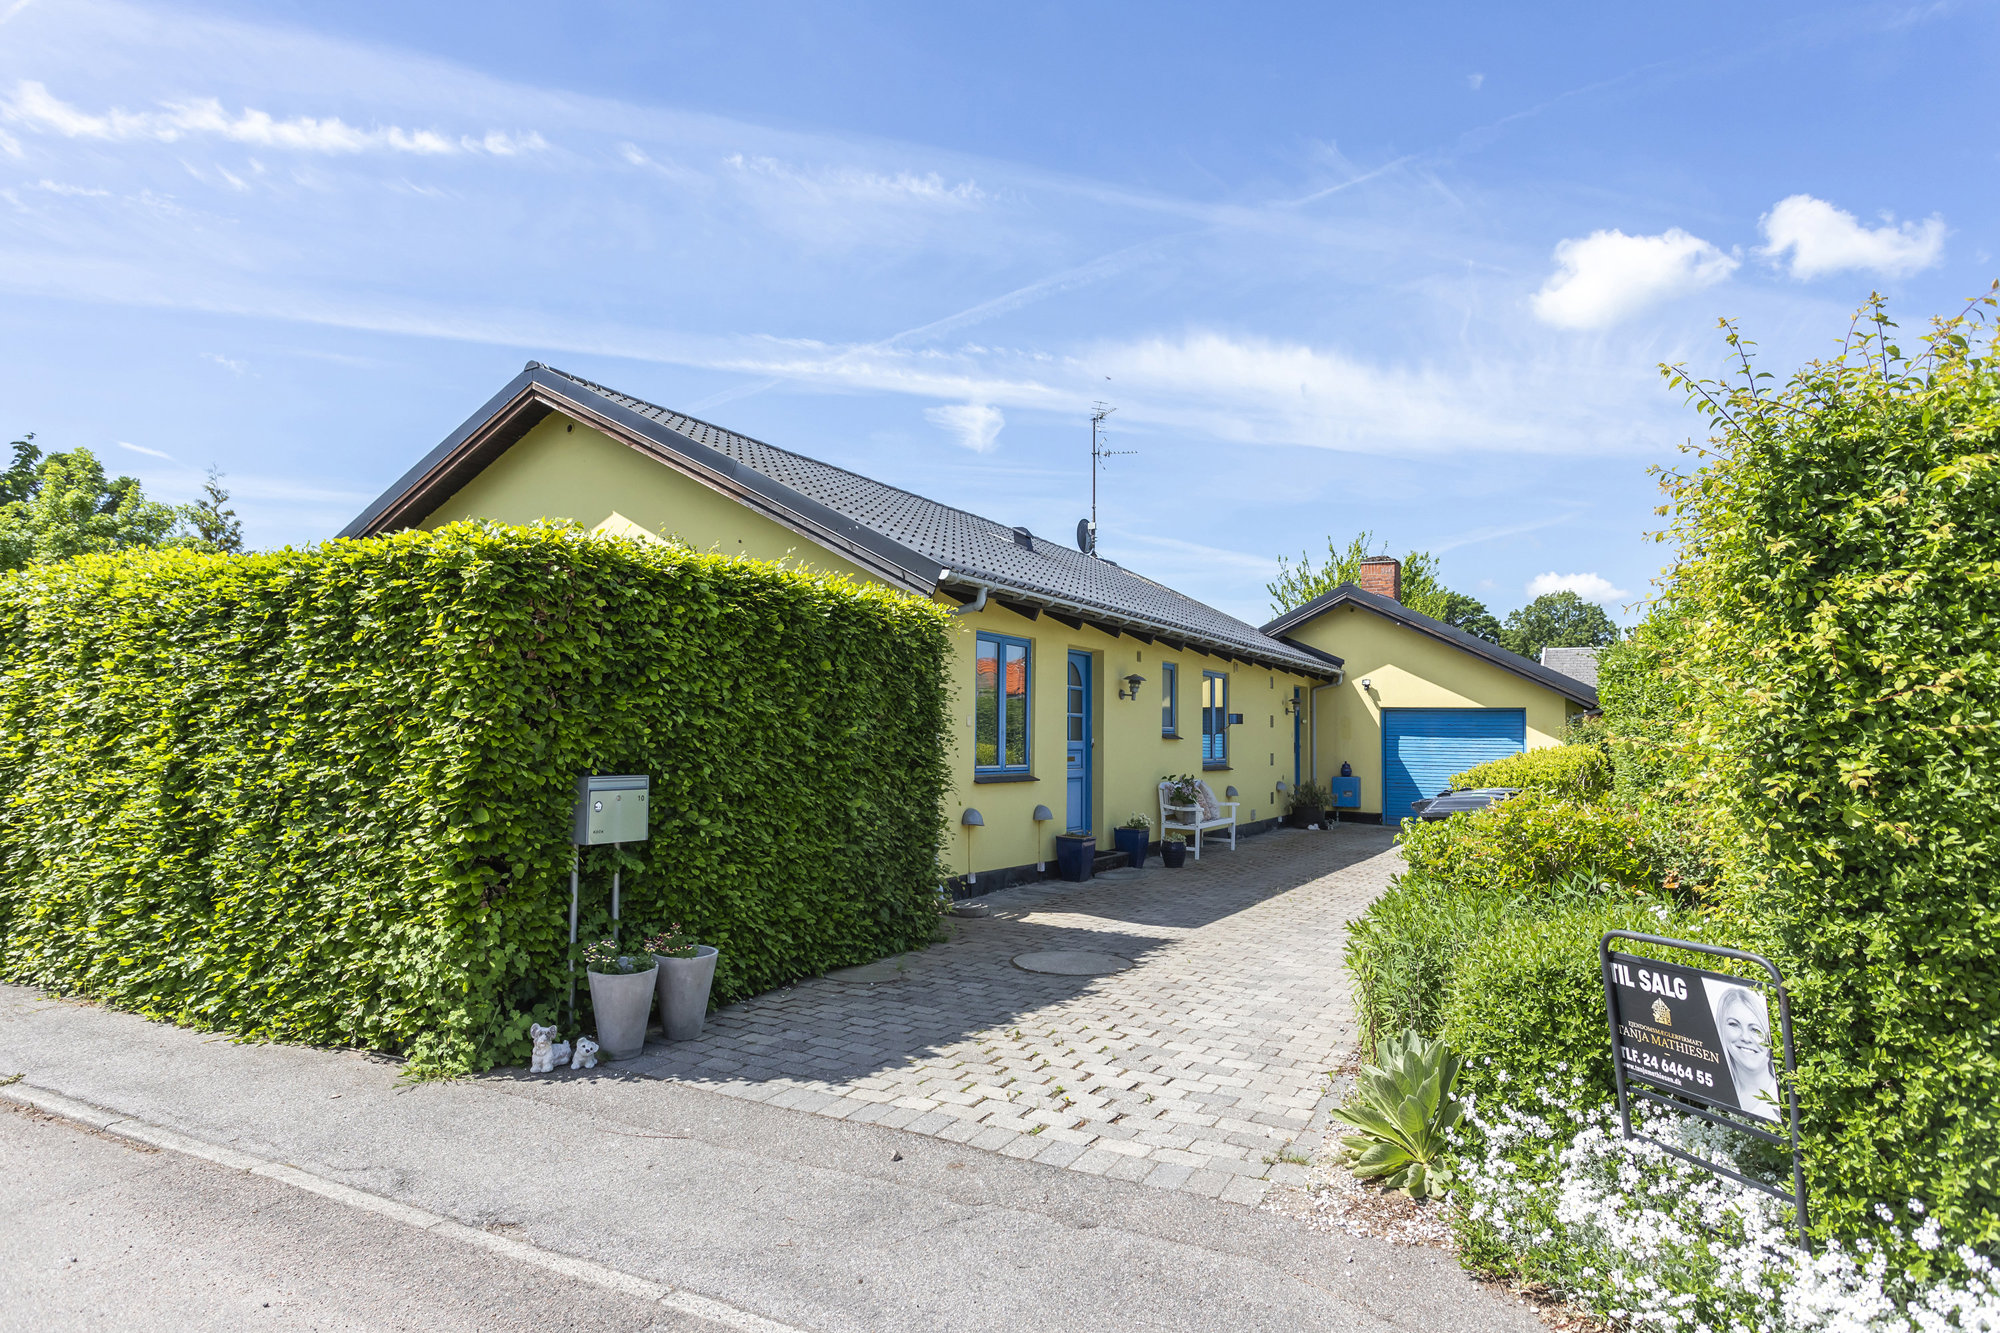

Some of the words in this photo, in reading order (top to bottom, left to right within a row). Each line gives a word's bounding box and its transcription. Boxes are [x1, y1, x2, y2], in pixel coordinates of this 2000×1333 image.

[1638, 969, 1688, 1001] SALG
[1618, 1024, 1650, 1043] TANJA
[1650, 1033, 1720, 1064] MATHIESEN
[1642, 1053, 1659, 1070] 24
[1661, 1058, 1694, 1082] 6464
[1696, 1069, 1714, 1088] 55
